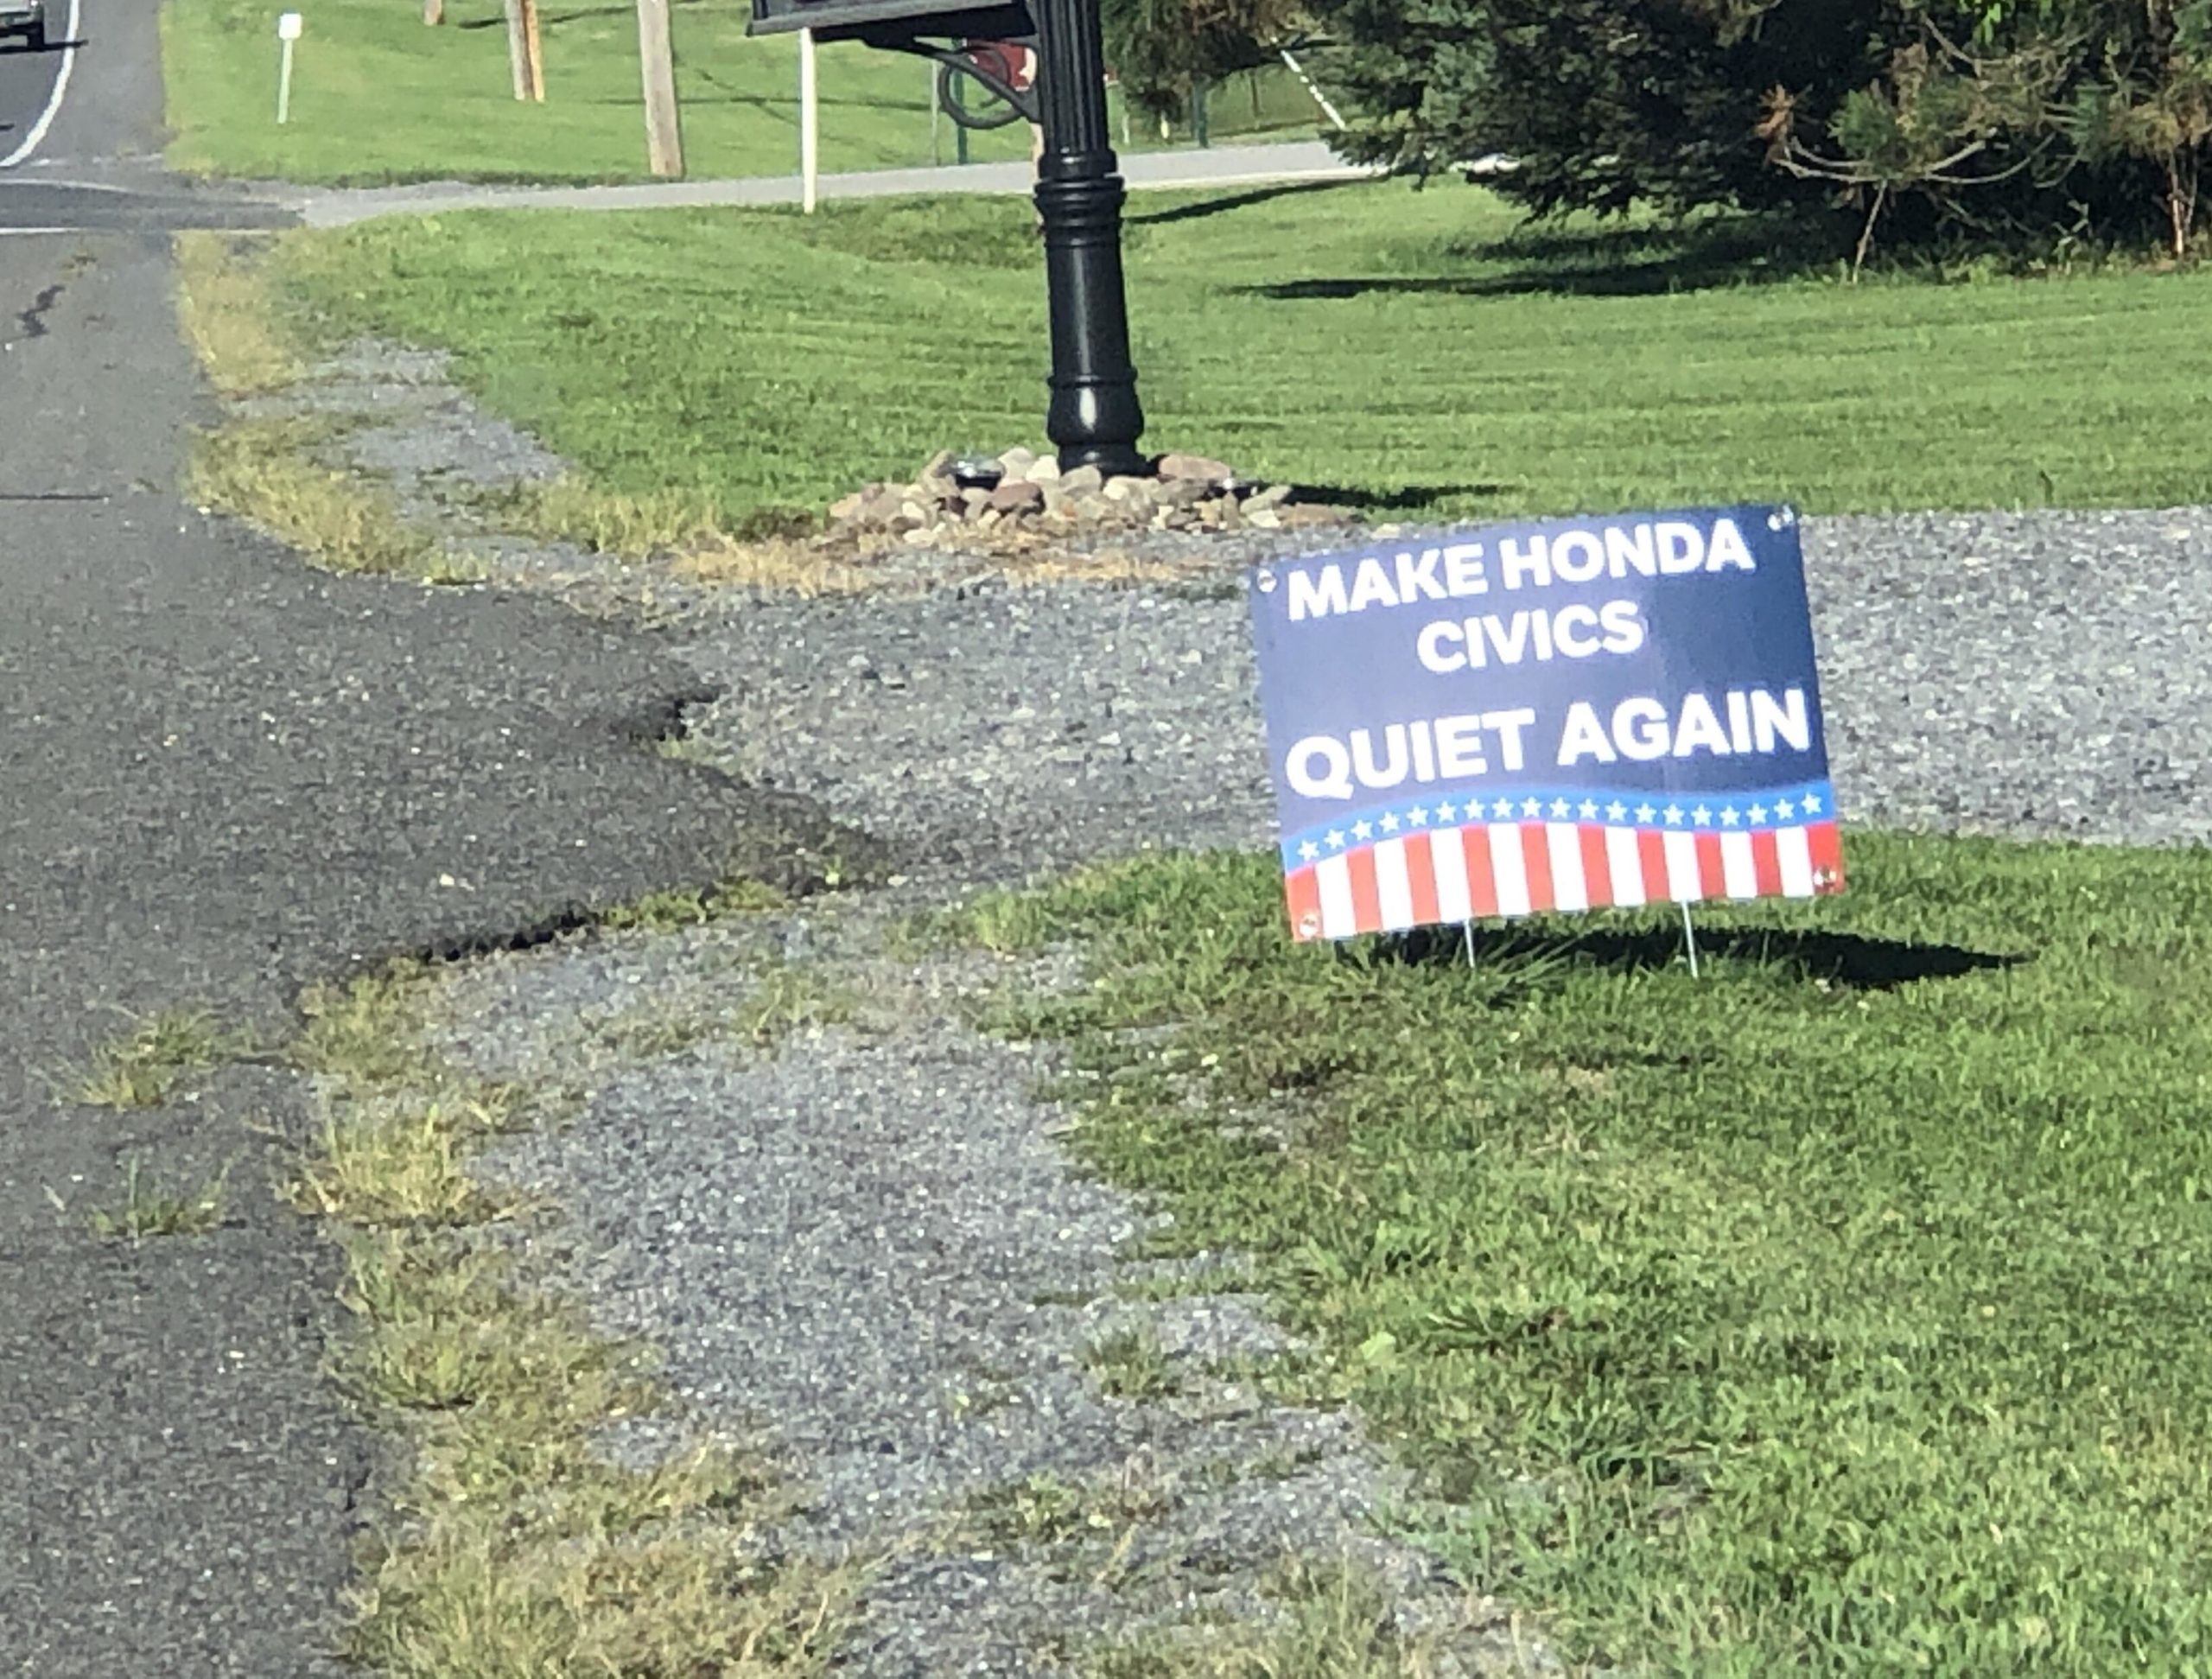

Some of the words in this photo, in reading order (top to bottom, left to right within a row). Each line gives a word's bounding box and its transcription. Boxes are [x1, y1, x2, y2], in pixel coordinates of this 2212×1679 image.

[1287, 543, 1488, 620] MAKE
[1499, 518, 1755, 590] HONDA
[1417, 601, 1643, 674] CIVICS
[1286, 708, 1535, 799] QUIET
[1556, 689, 1810, 767] AGAIN
